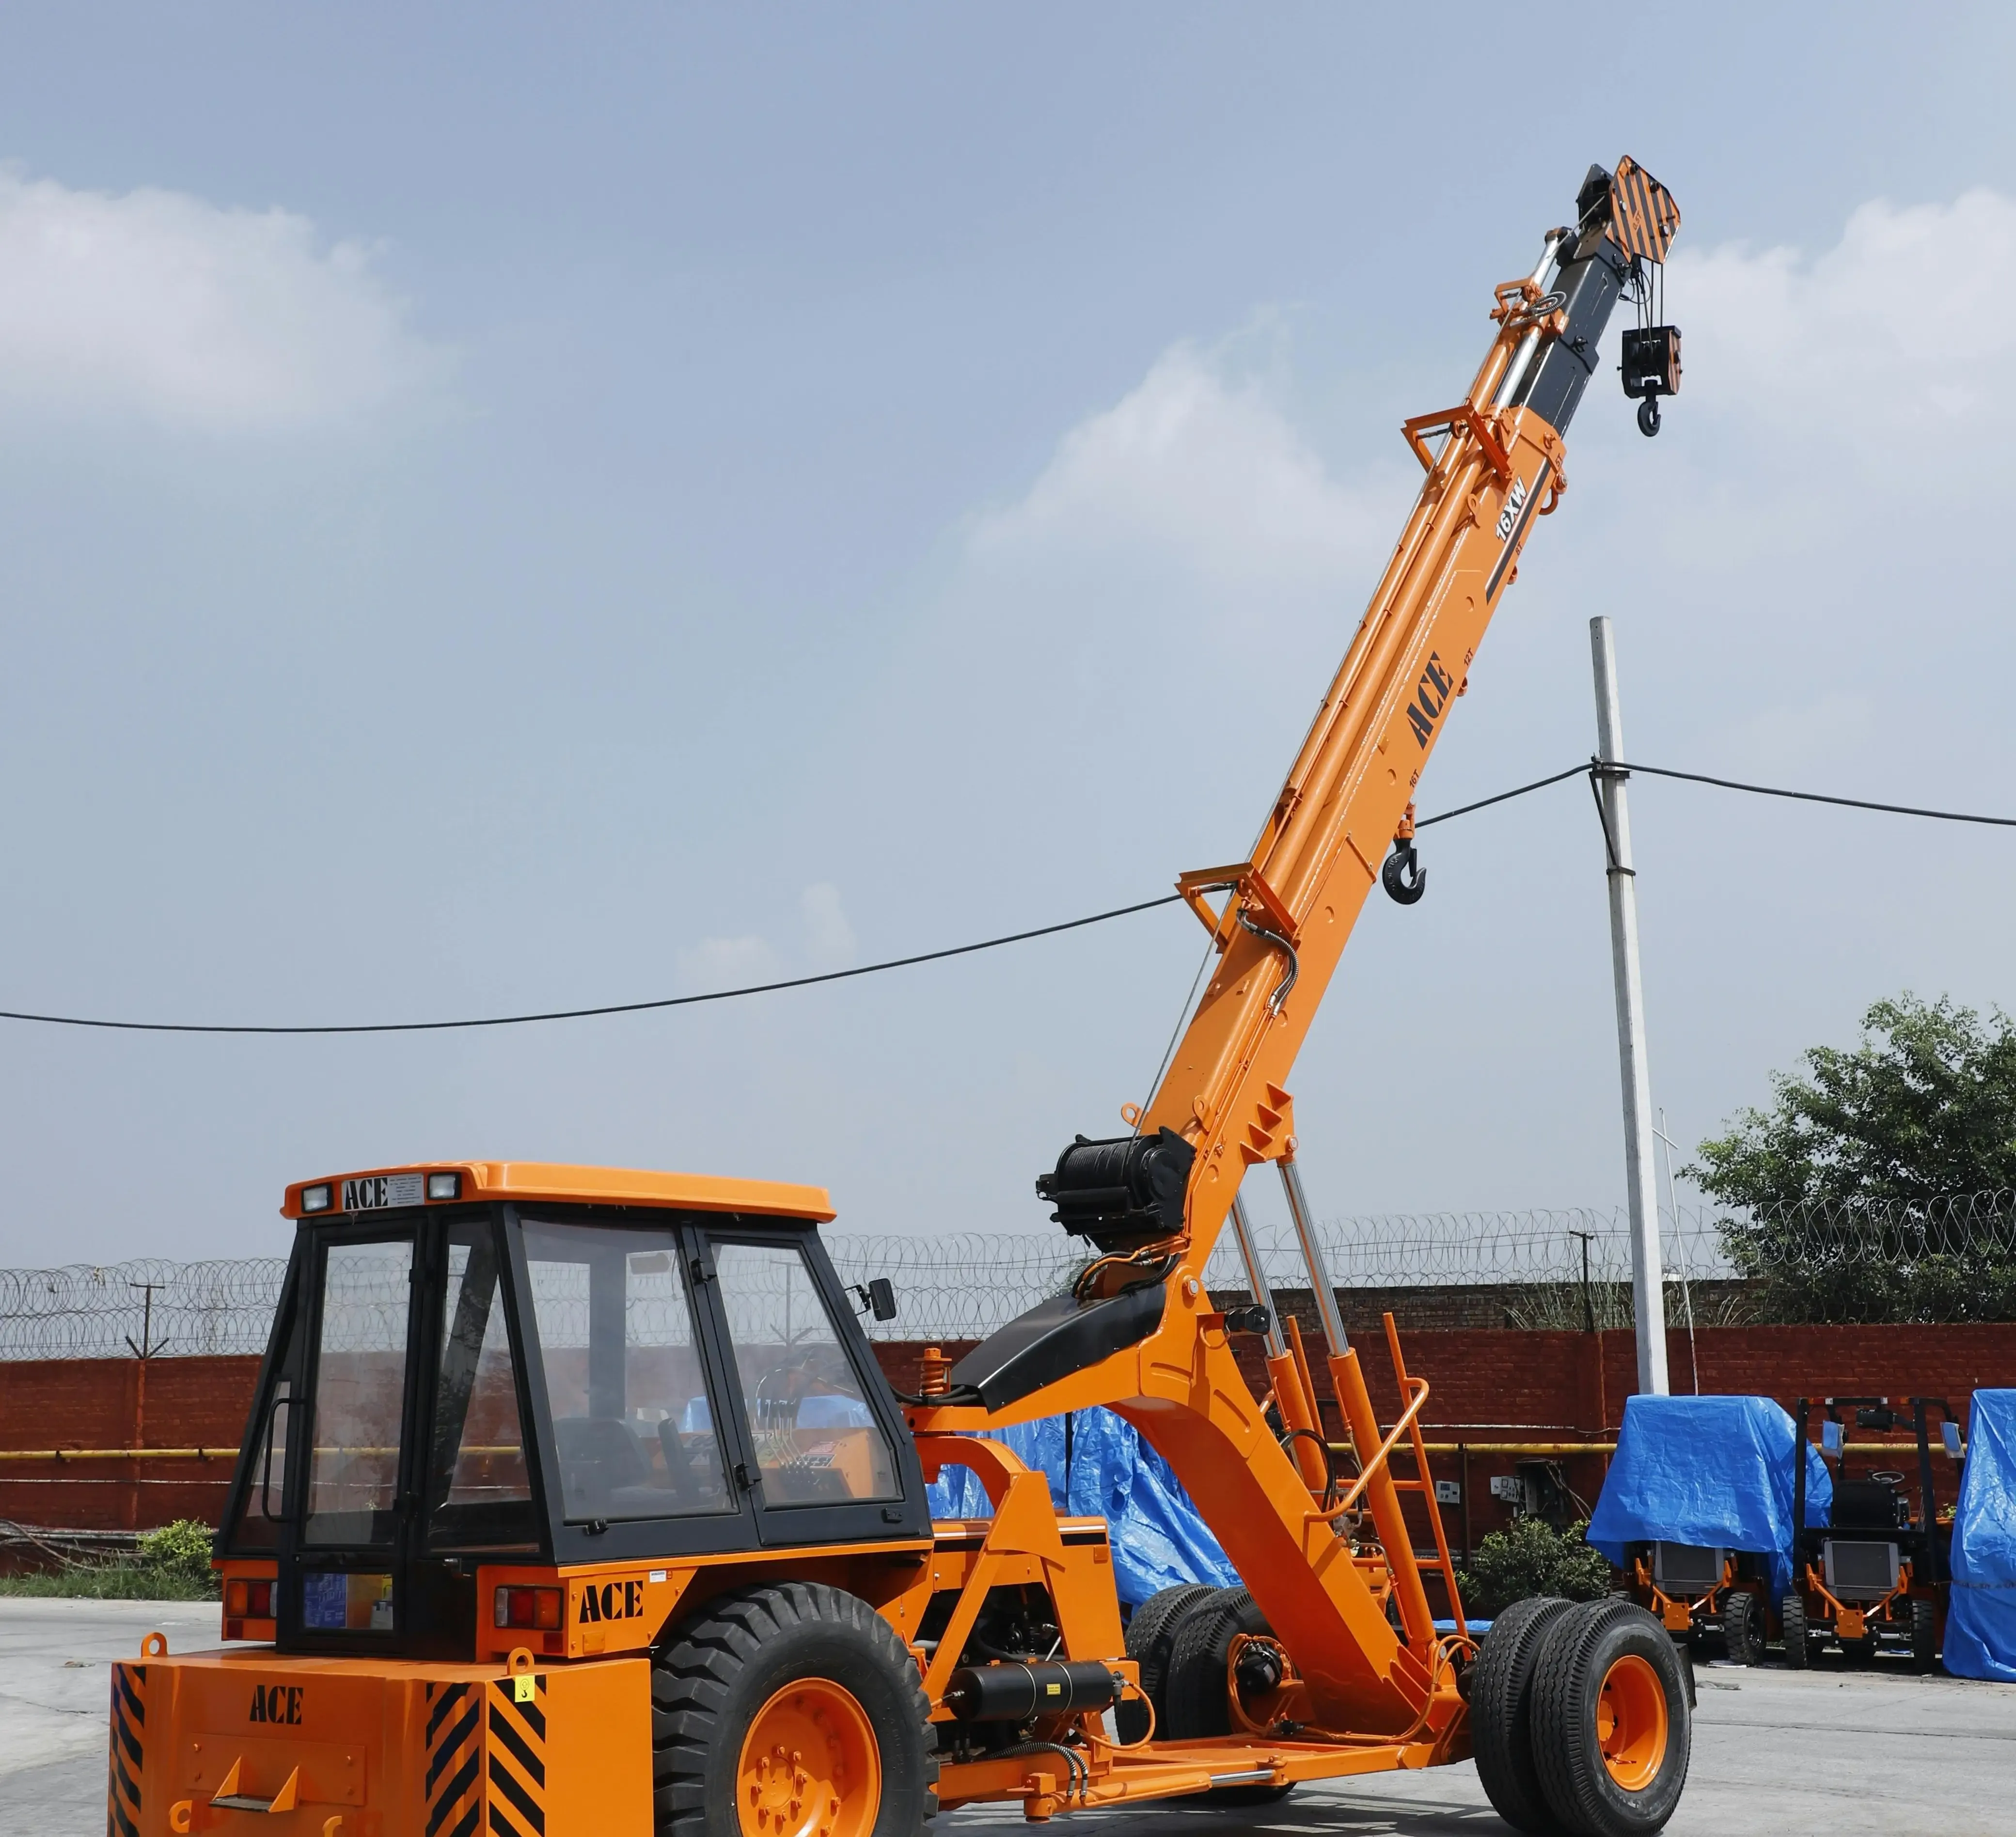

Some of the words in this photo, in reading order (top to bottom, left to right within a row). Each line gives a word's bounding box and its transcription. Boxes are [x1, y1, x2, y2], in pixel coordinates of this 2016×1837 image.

[1555, 453, 1562, 467] 5T
[1496, 475, 1528, 543] 16XW
[1464, 647, 1473, 666] 12T
[1406, 650, 1454, 751] ACE
[1409, 769, 1419, 788] 16T
[345, 1178, 388, 1210] ACE
[579, 1580, 643, 1623] ACE
[250, 1685, 303, 1725] ACE
